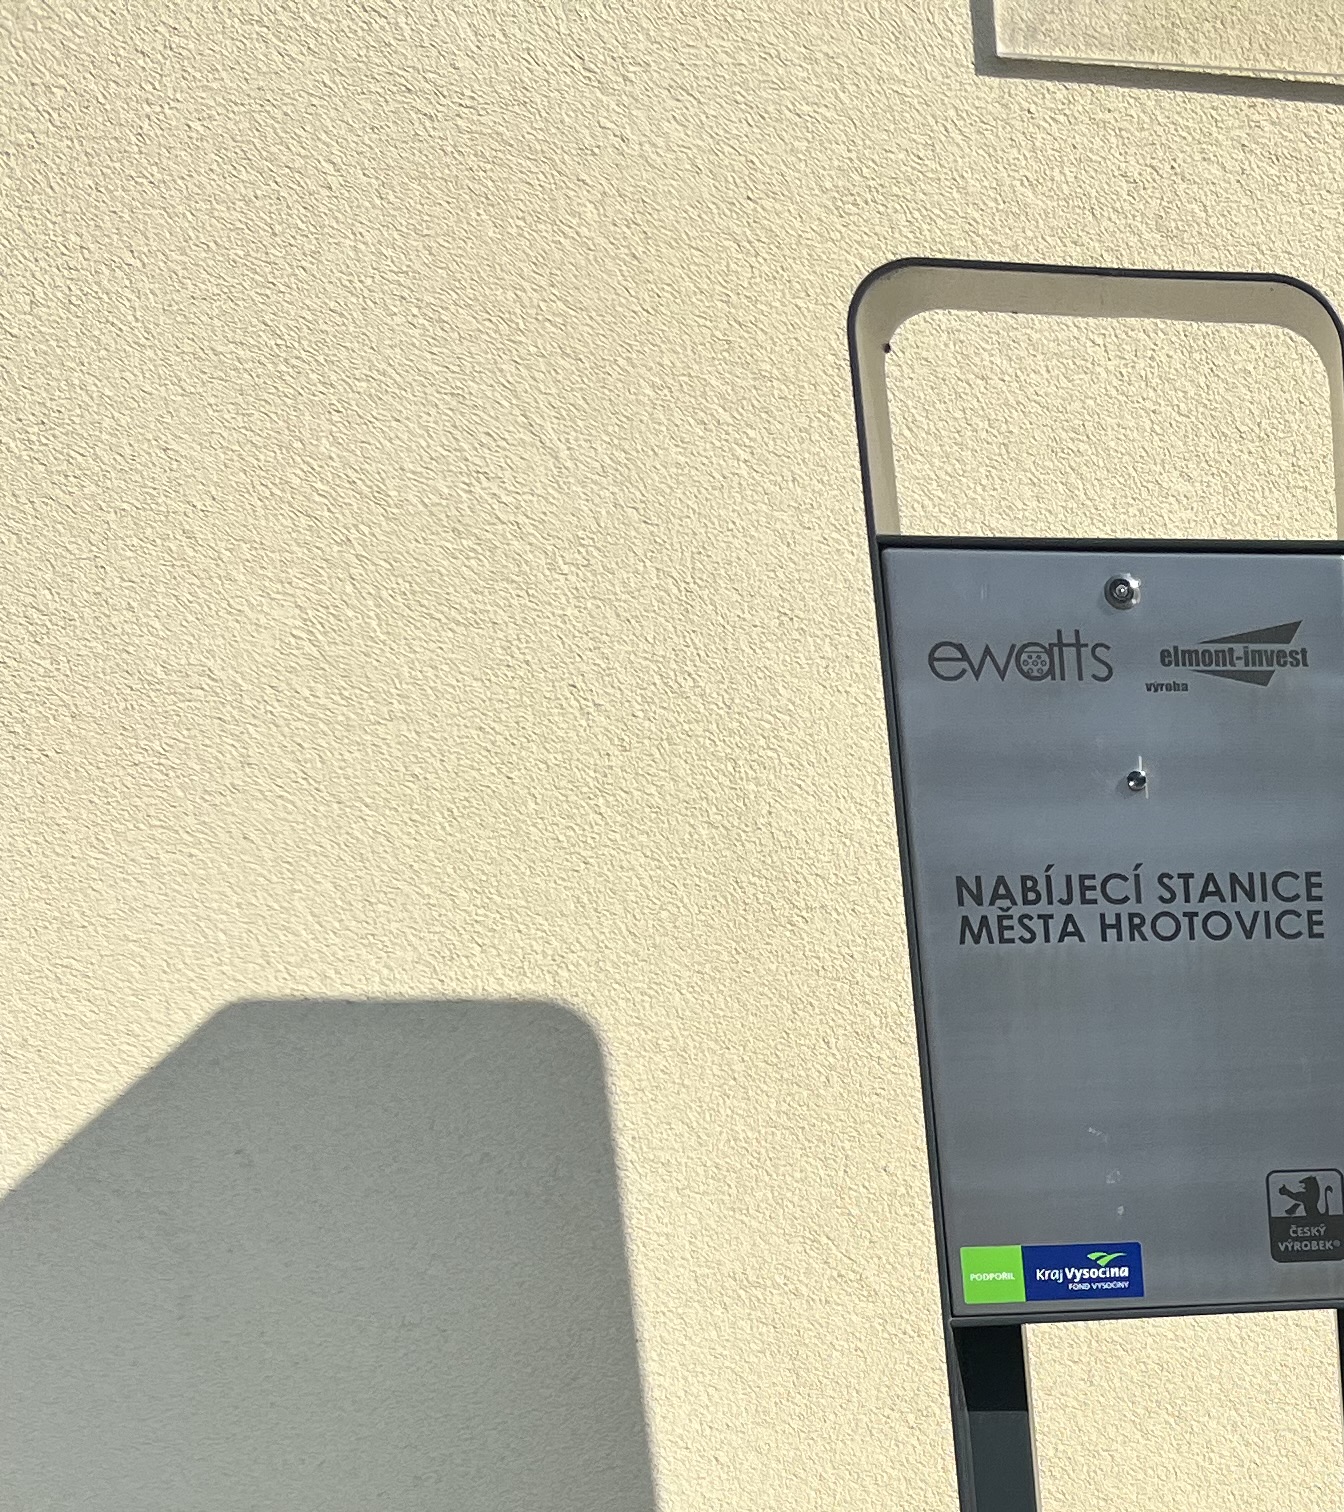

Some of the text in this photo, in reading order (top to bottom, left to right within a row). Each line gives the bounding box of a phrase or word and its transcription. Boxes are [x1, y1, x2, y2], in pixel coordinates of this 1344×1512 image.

[927, 629, 1114, 682] ewatts
[1159, 644, 1309, 669] elmont-invest
[955, 863, 1324, 907] NABÍJECÍ STANICE
[959, 906, 1325, 945] MĚSTA HROTOVICE
[1289, 1223, 1326, 1237] ČESKÝ
[1036, 1268, 1063, 1283] Kraj
